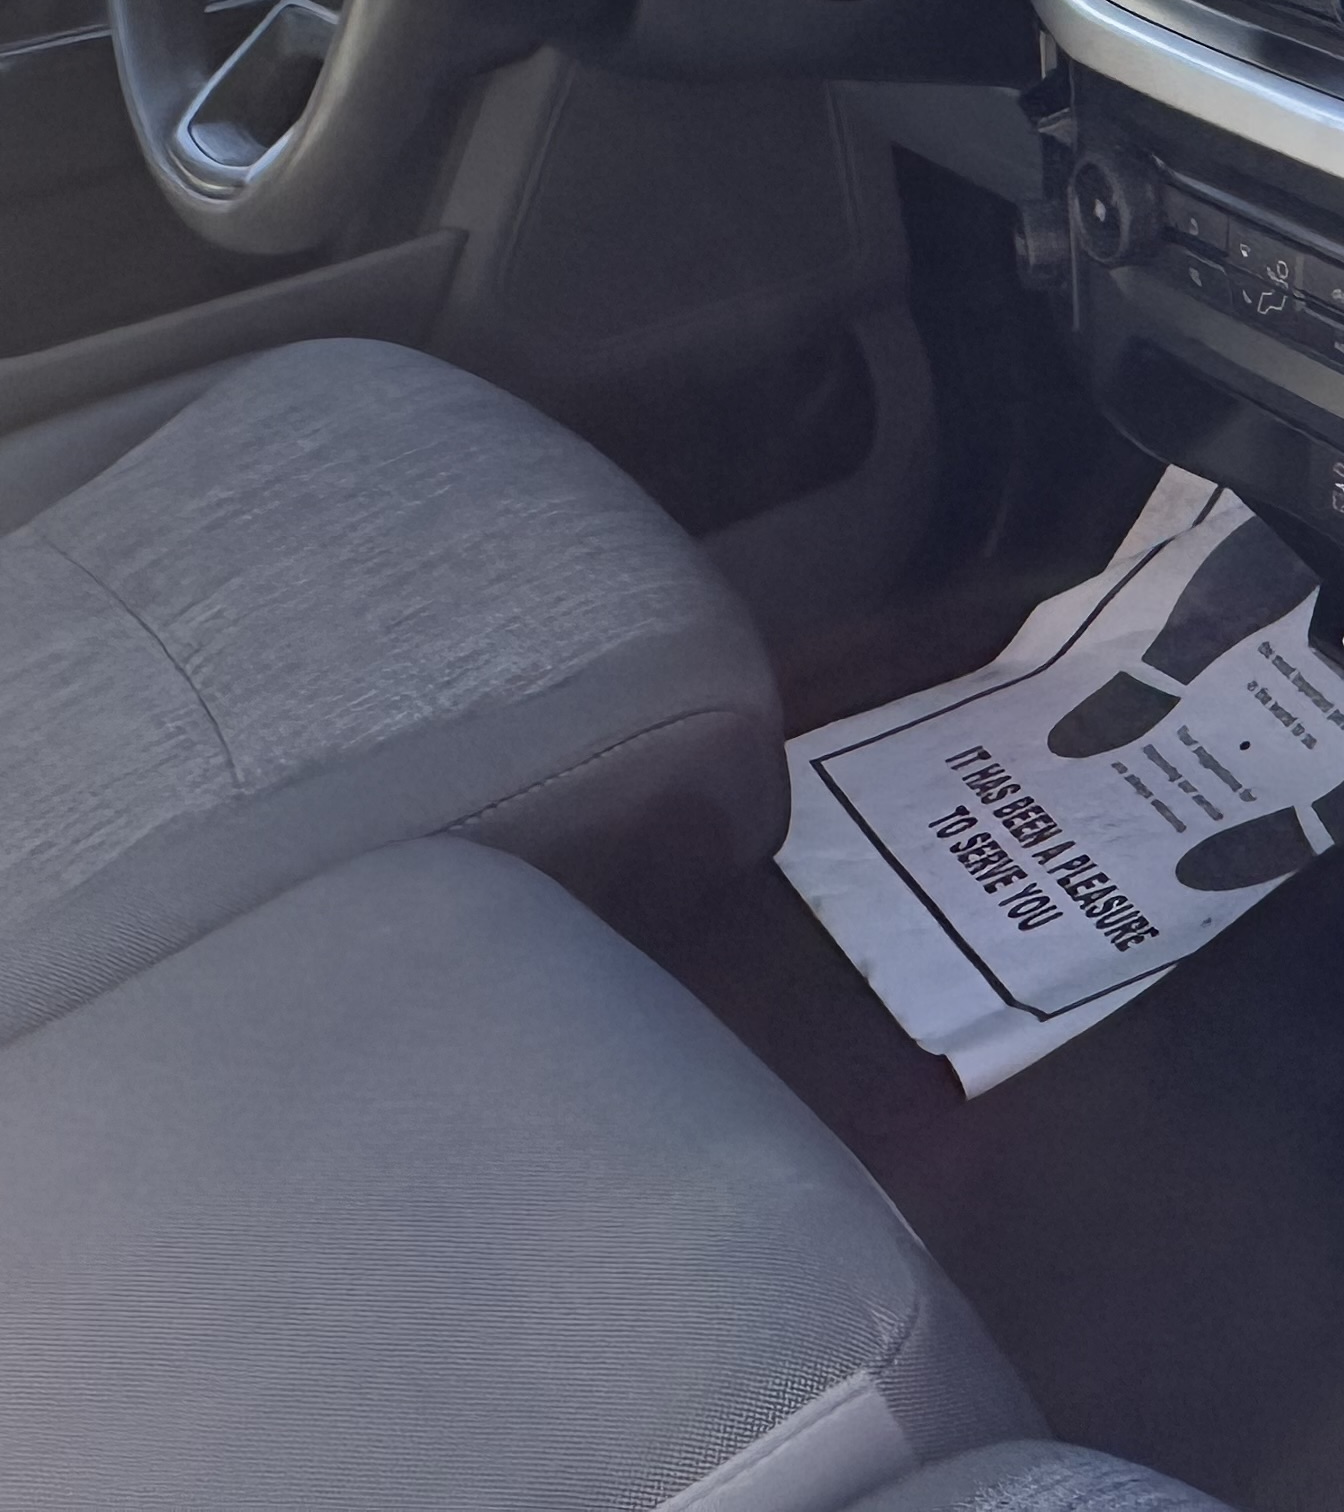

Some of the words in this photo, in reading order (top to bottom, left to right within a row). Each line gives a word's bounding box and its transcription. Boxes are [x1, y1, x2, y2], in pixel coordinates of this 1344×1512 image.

[945, 745, 990, 771] IT
[962, 760, 1022, 804] HAS
[927, 804, 979, 840] TO
[992, 795, 1063, 848] BEEN
[948, 831, 1028, 894] SERVE
[1031, 840, 1076, 867] A
[998, 882, 1064, 934] YOU
[1050, 854, 1160, 954] PLEASURE
